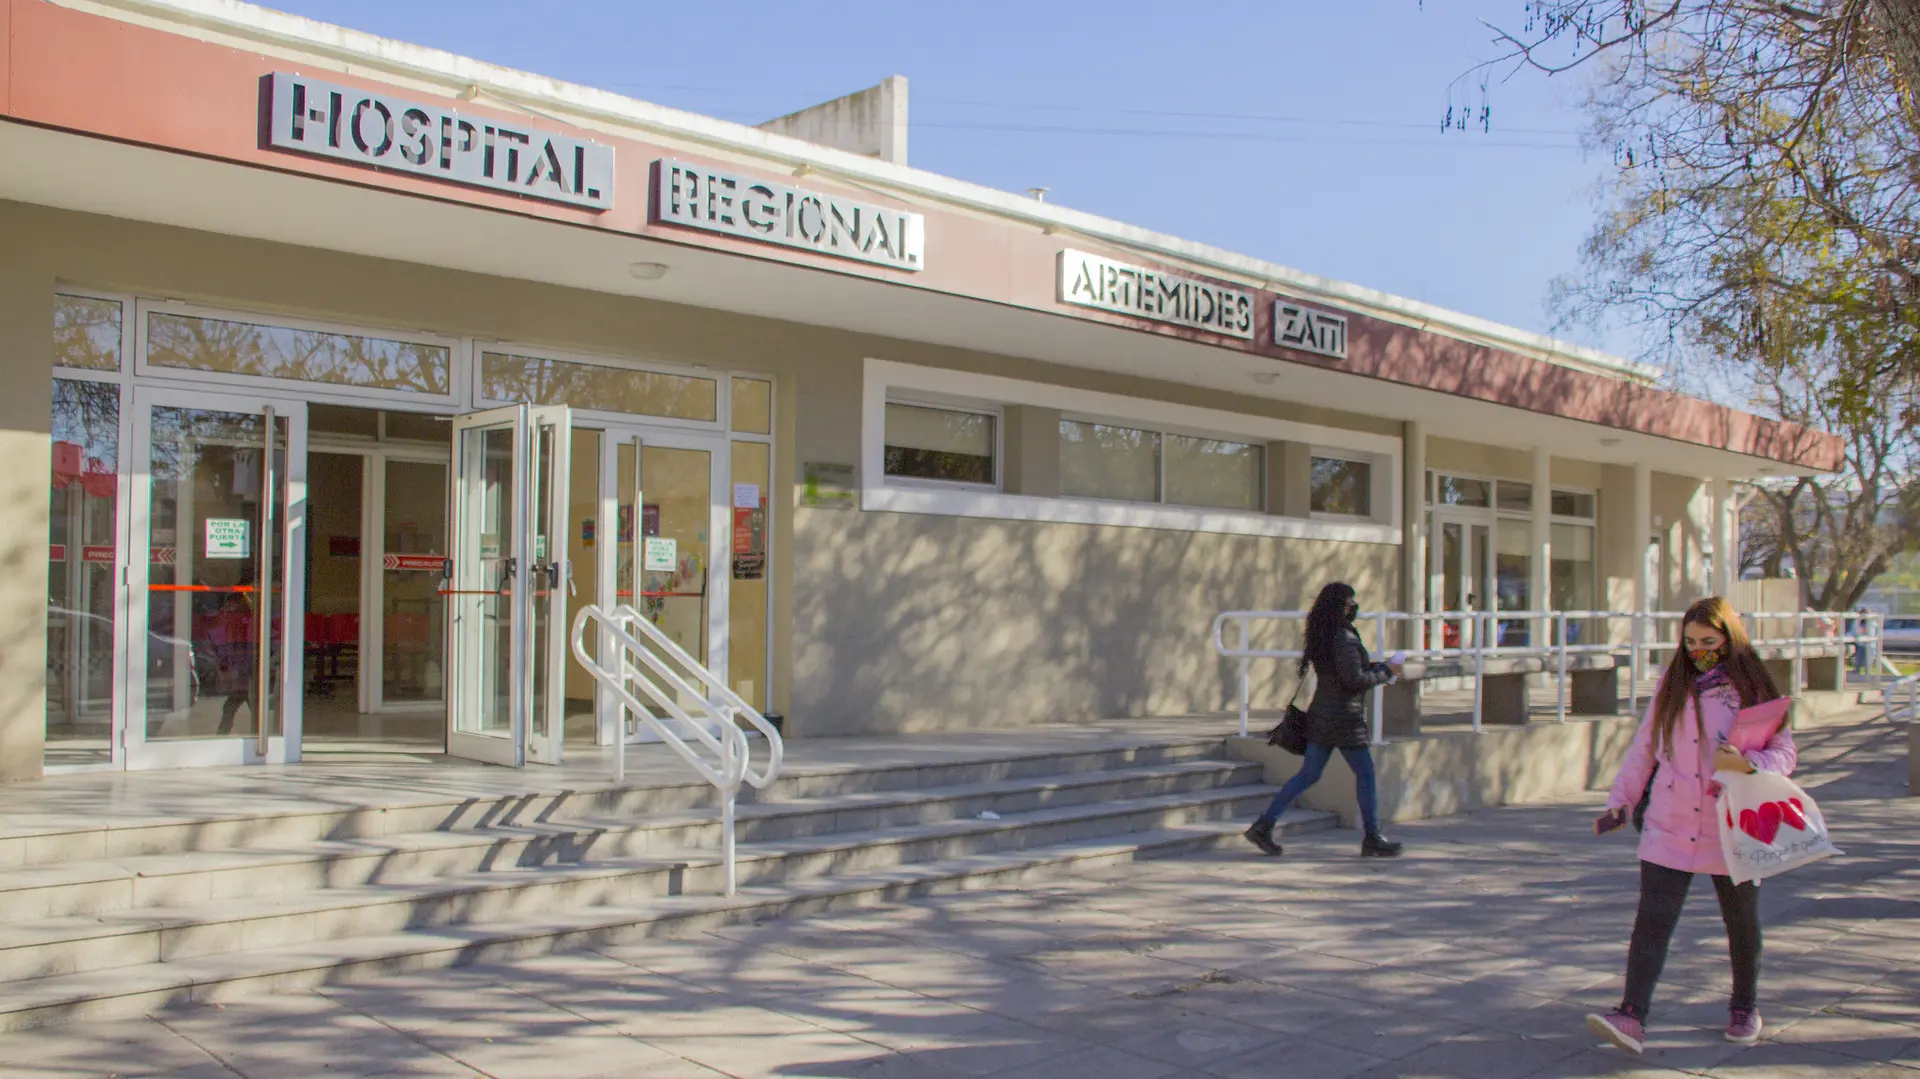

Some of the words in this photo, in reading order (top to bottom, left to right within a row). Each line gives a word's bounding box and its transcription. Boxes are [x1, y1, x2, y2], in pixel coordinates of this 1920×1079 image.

[291, 82, 601, 200] HOSPITAL
[670, 166, 917, 263] REGIONAL
[1072, 260, 1250, 332] ARTEMIDES
